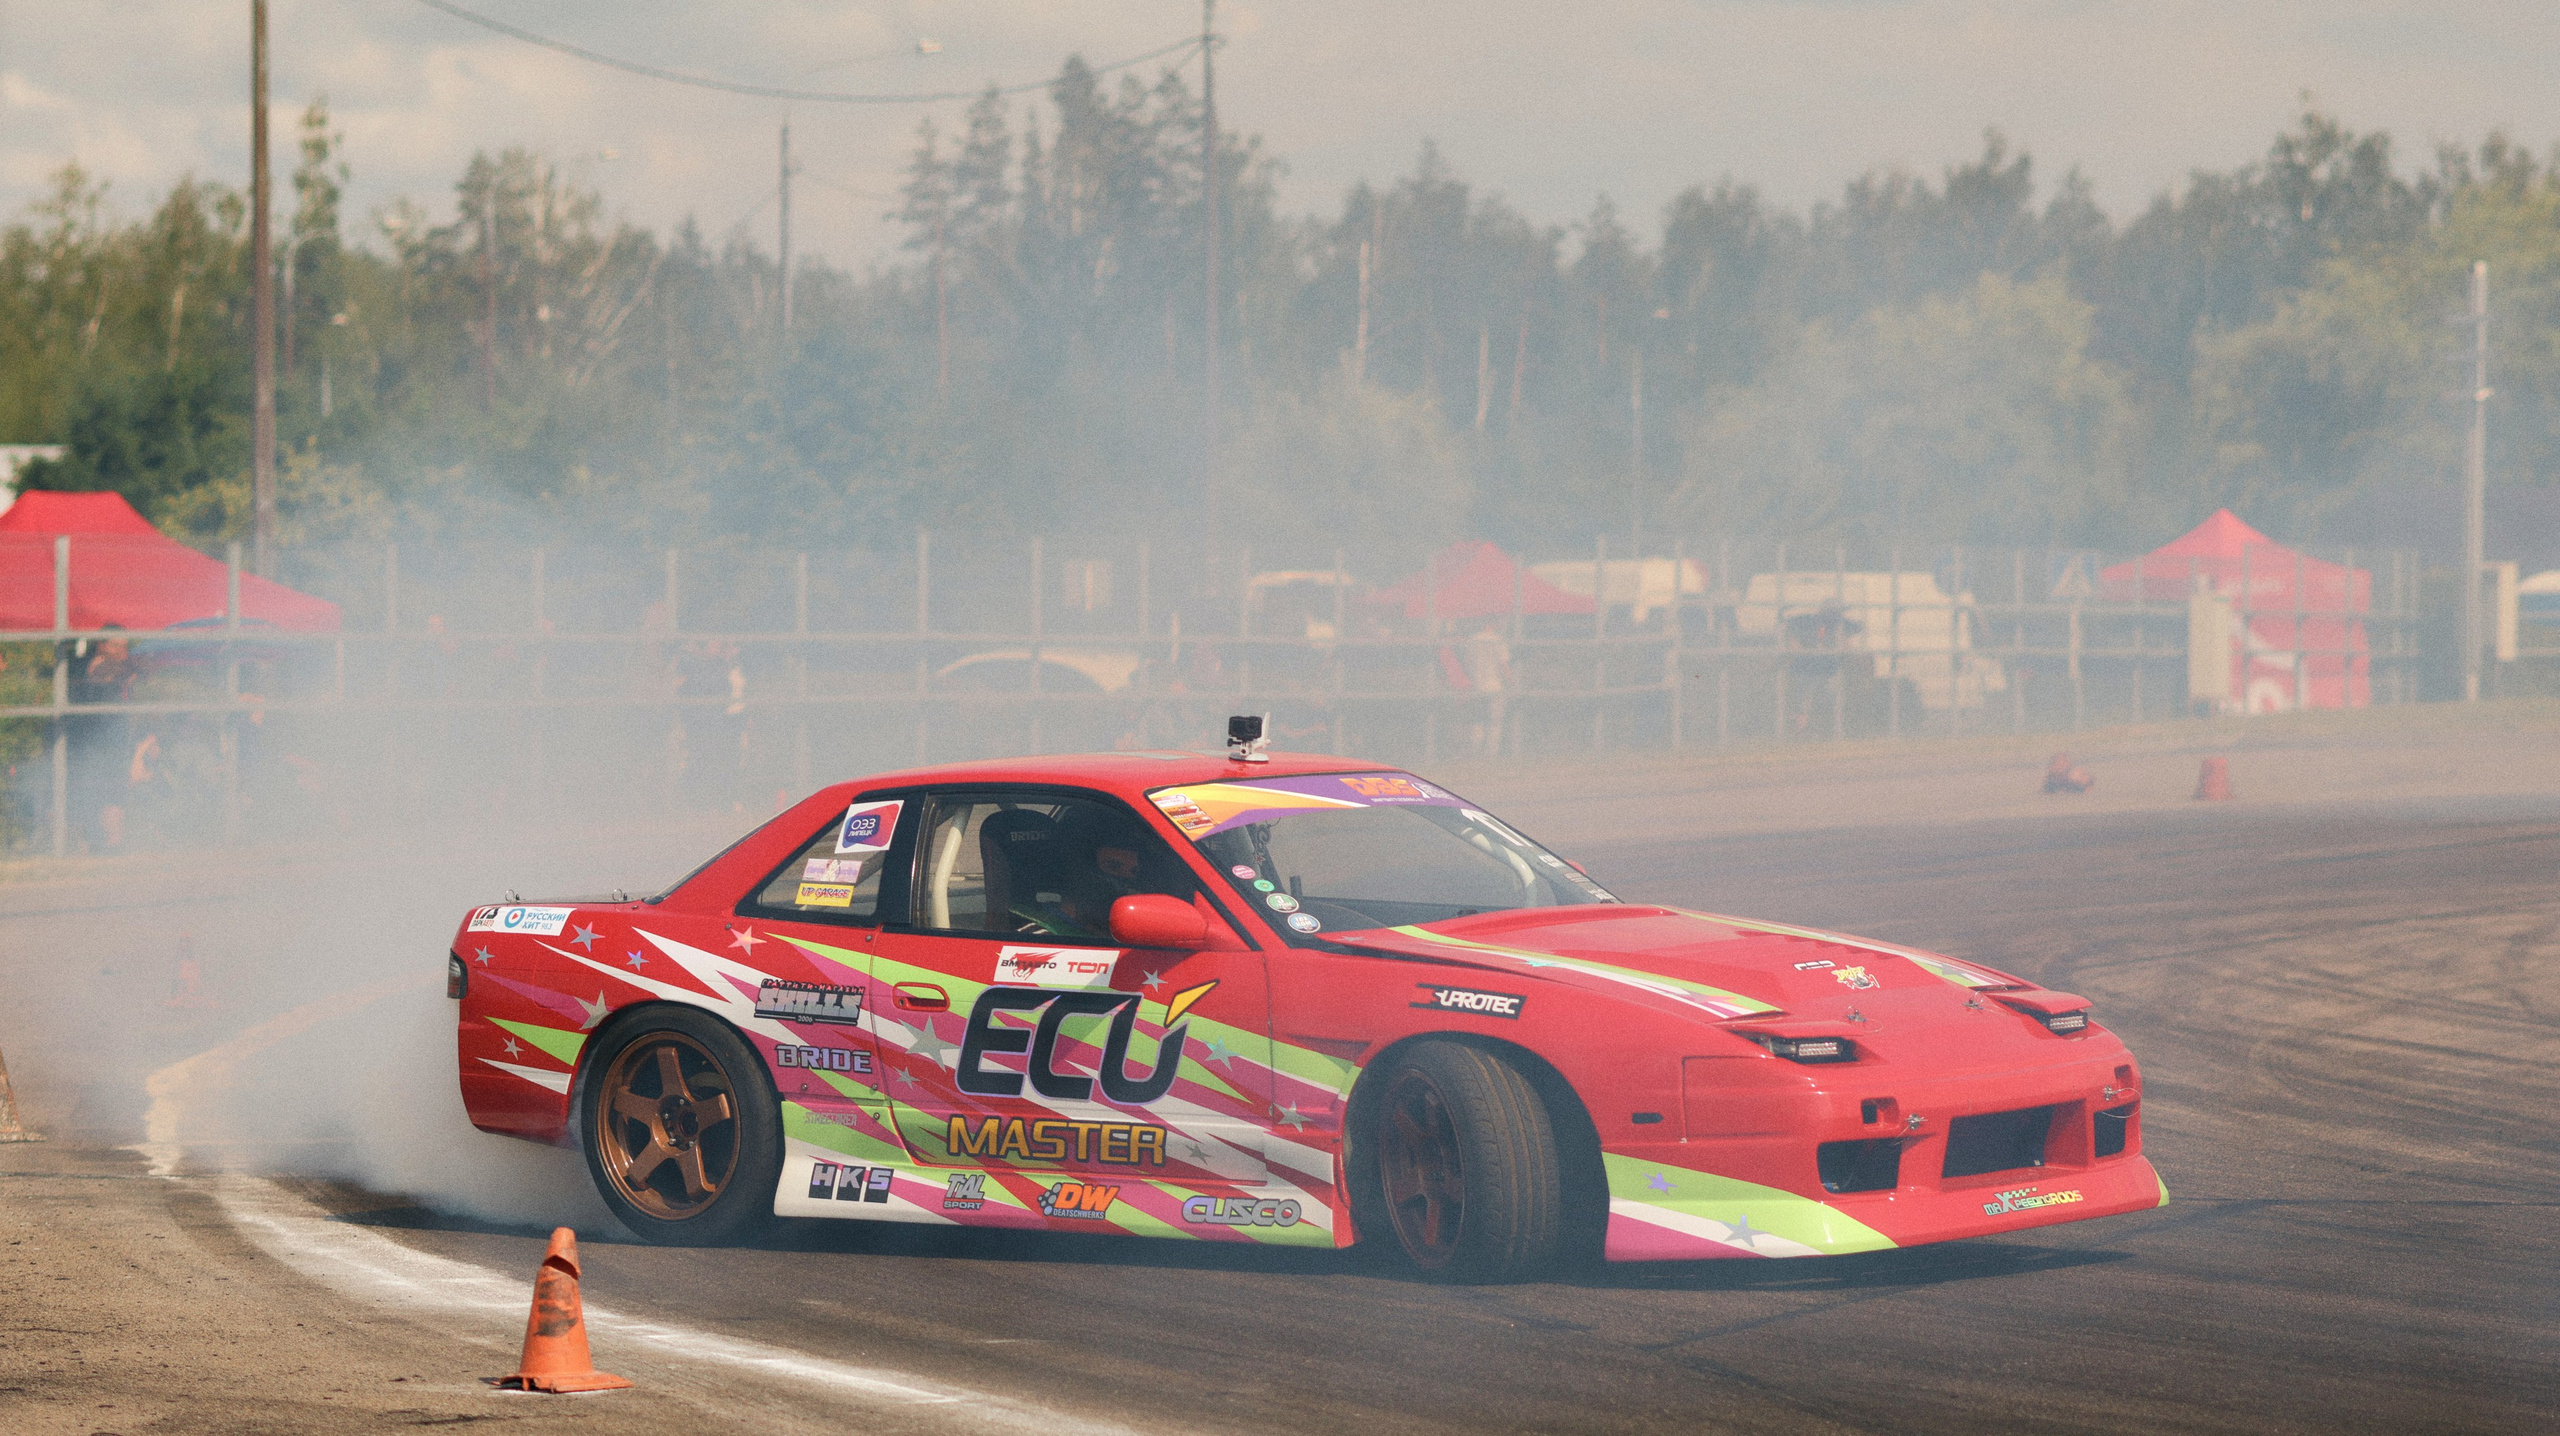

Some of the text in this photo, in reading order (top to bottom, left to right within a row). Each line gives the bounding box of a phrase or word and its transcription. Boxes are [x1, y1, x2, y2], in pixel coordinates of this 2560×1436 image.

[851, 818, 876, 830] ОЭЗ
[848, 829, 873, 837] ЛИПЕЦК
[801, 887, 850, 899] UP GARAGE
[526, 911, 566, 922] РУССКИЙ
[522, 921, 540, 930] ХИТ
[755, 987, 863, 1019] SKILLS
[797, 1015, 813, 1023] 2006
[955, 979, 1219, 1106] ECU
[775, 1044, 872, 1073] BRIDE
[948, 1114, 1166, 1165] MASTER
[810, 1163, 892, 1195] HKS
[1055, 1182, 1119, 1211] DW
[943, 1200, 983, 1210] SPORT
[1182, 1195, 1301, 1227] CUSCO
[1053, 1207, 1105, 1219] DEATSCHWERKS
